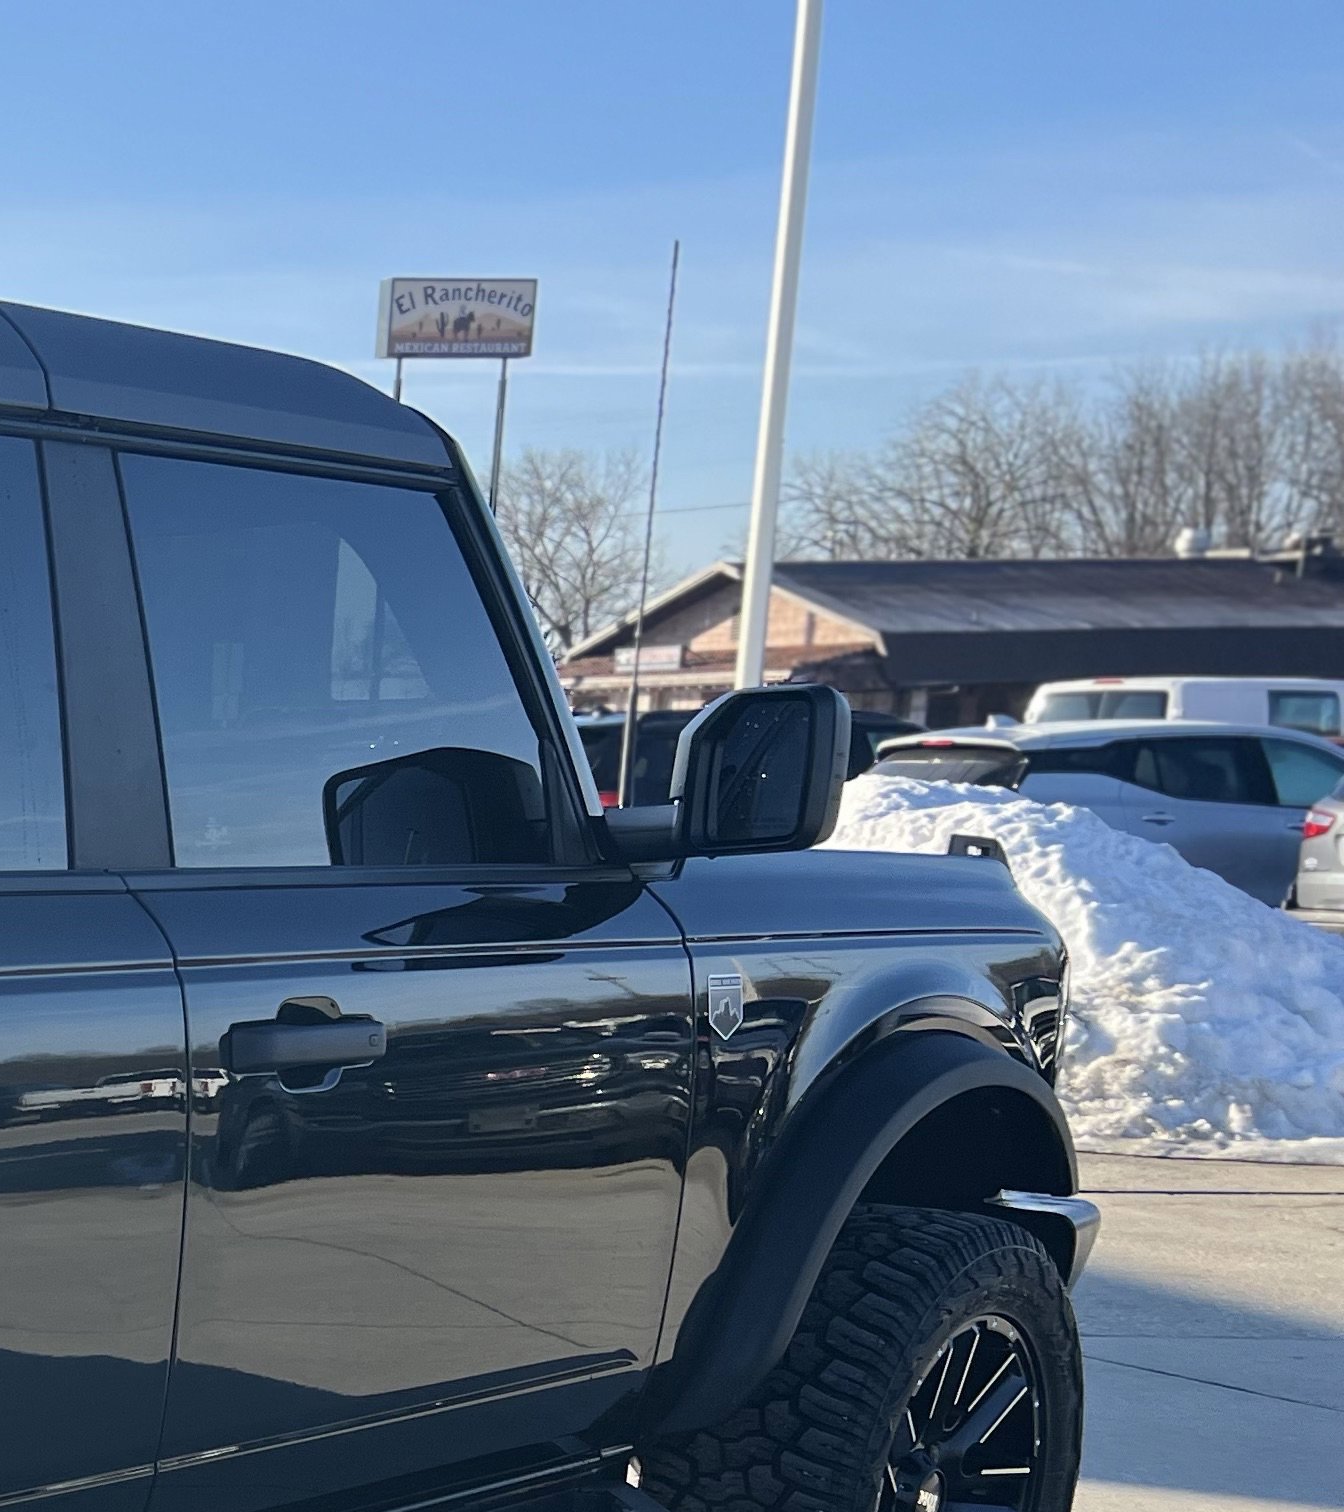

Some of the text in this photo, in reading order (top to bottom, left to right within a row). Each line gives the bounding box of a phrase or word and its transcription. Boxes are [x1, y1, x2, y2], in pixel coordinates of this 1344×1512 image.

[395, 283, 533, 317] El Rancherito
[395, 342, 528, 354] MEXICAN RESTAURANT
